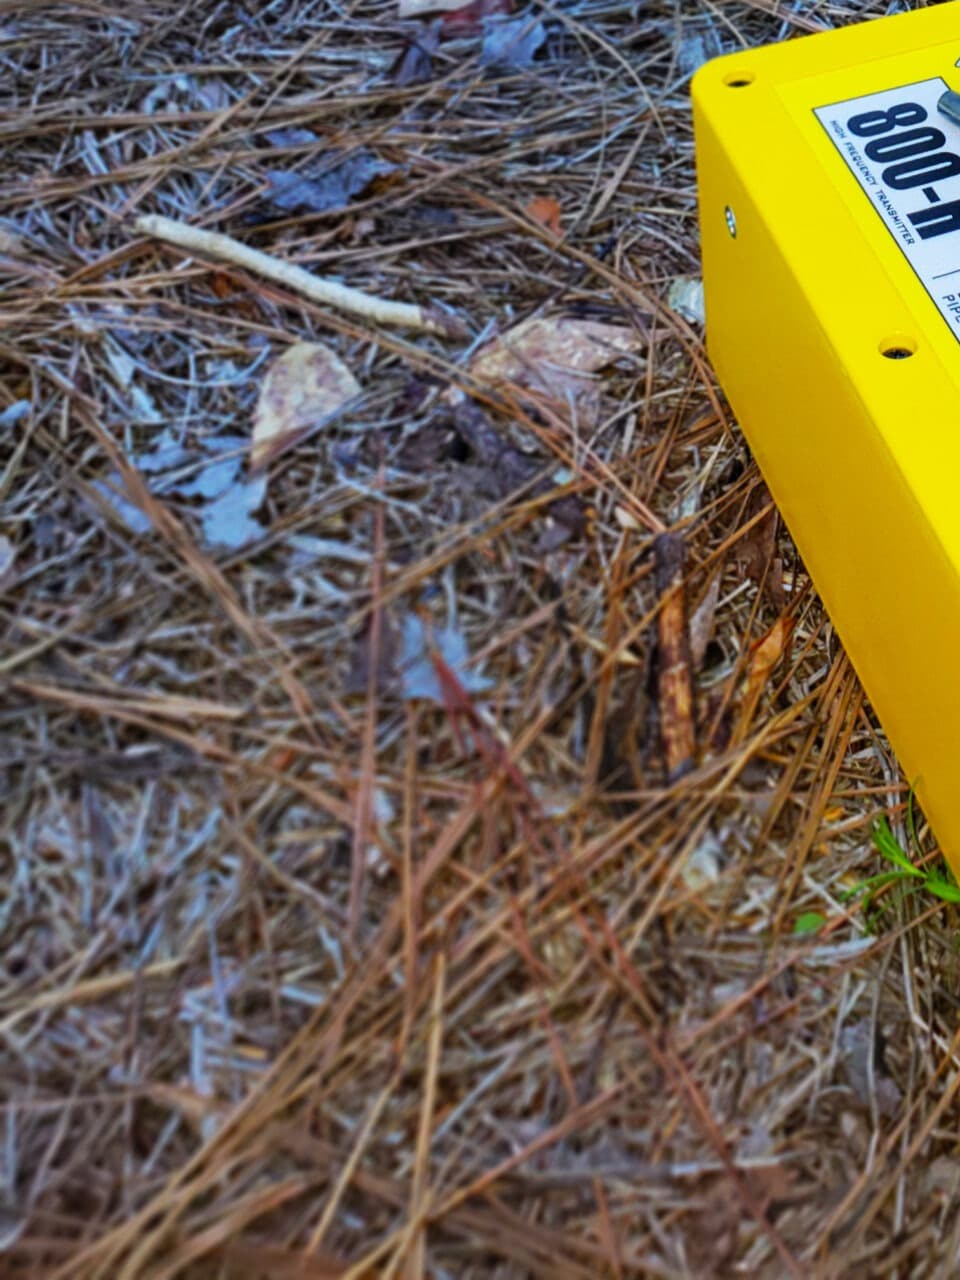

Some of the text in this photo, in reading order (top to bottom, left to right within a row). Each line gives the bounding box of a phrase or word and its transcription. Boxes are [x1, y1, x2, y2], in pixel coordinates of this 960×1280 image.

[831, 119, 915, 245] HIGH FREQUENCY TRANSMITTER
